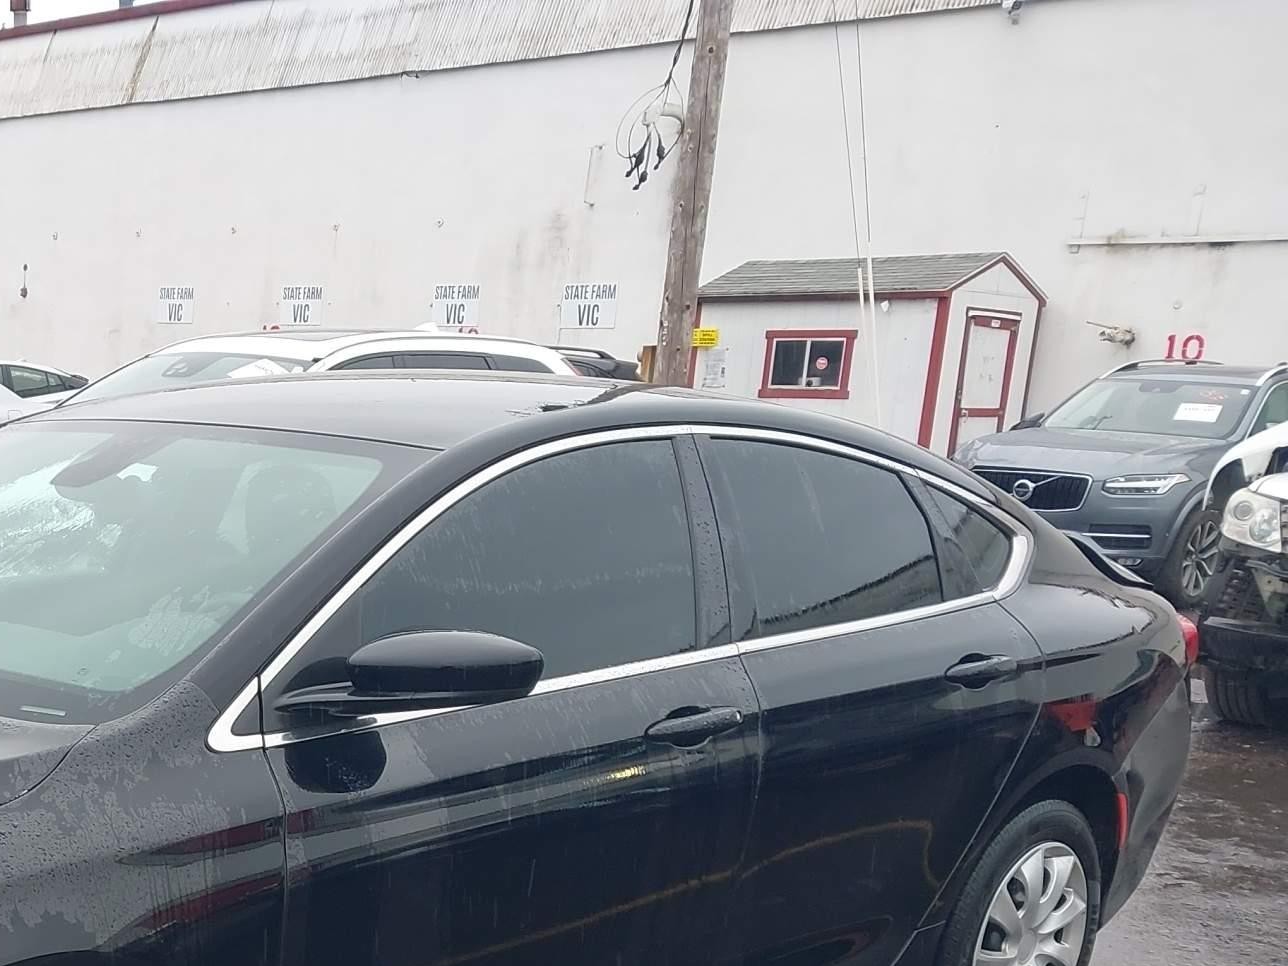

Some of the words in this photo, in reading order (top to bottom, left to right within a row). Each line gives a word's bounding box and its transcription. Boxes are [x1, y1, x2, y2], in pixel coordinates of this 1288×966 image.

[160, 288, 176, 300] STATE
[177, 287, 194, 300] FARM
[283, 287, 301, 300] STATE
[303, 286, 322, 300] FARM
[435, 285, 456, 300] STATE
[457, 284, 480, 300] FARM
[564, 285, 589, 300] STATE
[591, 284, 617, 300] FARM
[168, 303, 183, 322] VIC
[292, 304, 310, 323] VIC
[446, 303, 465, 325] VIC
[577, 304, 600, 326] VIC
[1165, 334, 1205, 362] 10
